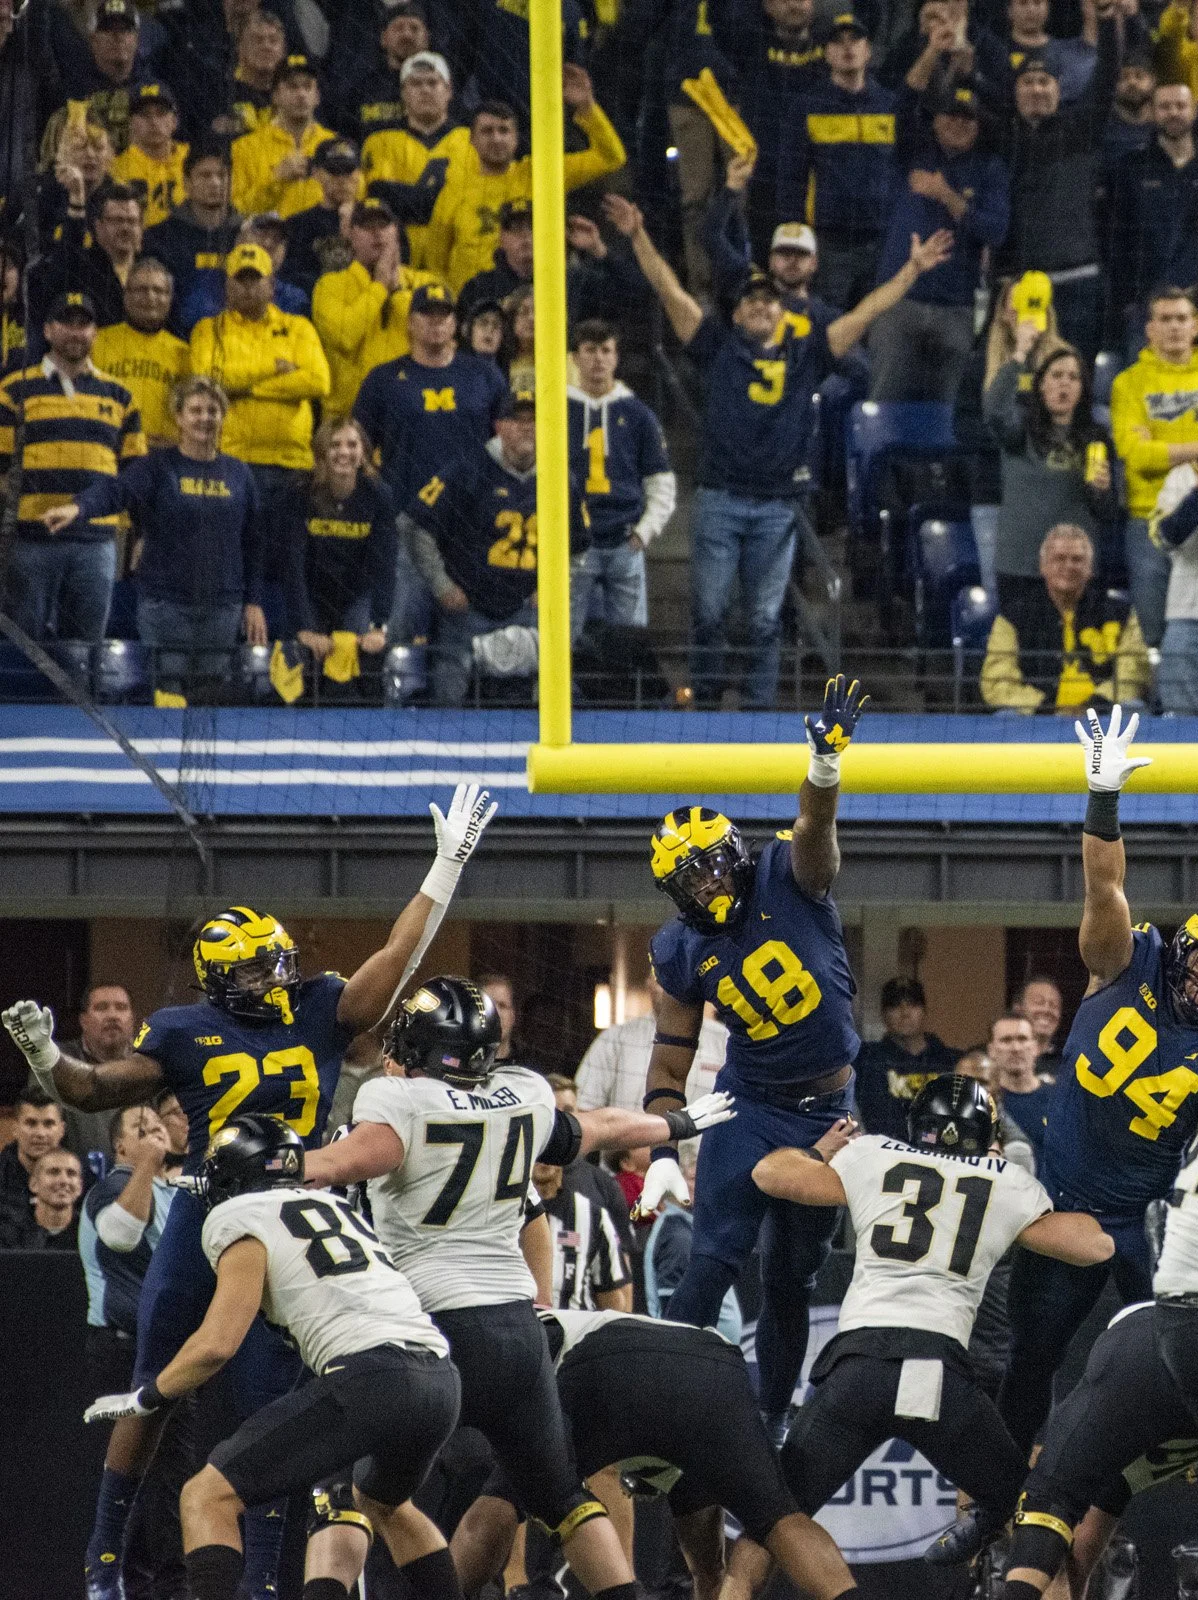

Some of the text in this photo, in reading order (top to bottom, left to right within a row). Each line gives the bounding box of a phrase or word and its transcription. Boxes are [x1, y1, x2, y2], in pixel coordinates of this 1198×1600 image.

[422, 387, 457, 412] M
[585, 427, 611, 494] 1
[824, 723, 851, 753] M
[1090, 718, 1103, 774] MICHIGAN
[717, 939, 822, 1041] 18
[202, 1045, 320, 1137] 23
[446, 1089, 468, 1110] E.
[424, 1113, 535, 1227] 74
[870, 1161, 995, 1277] 31
